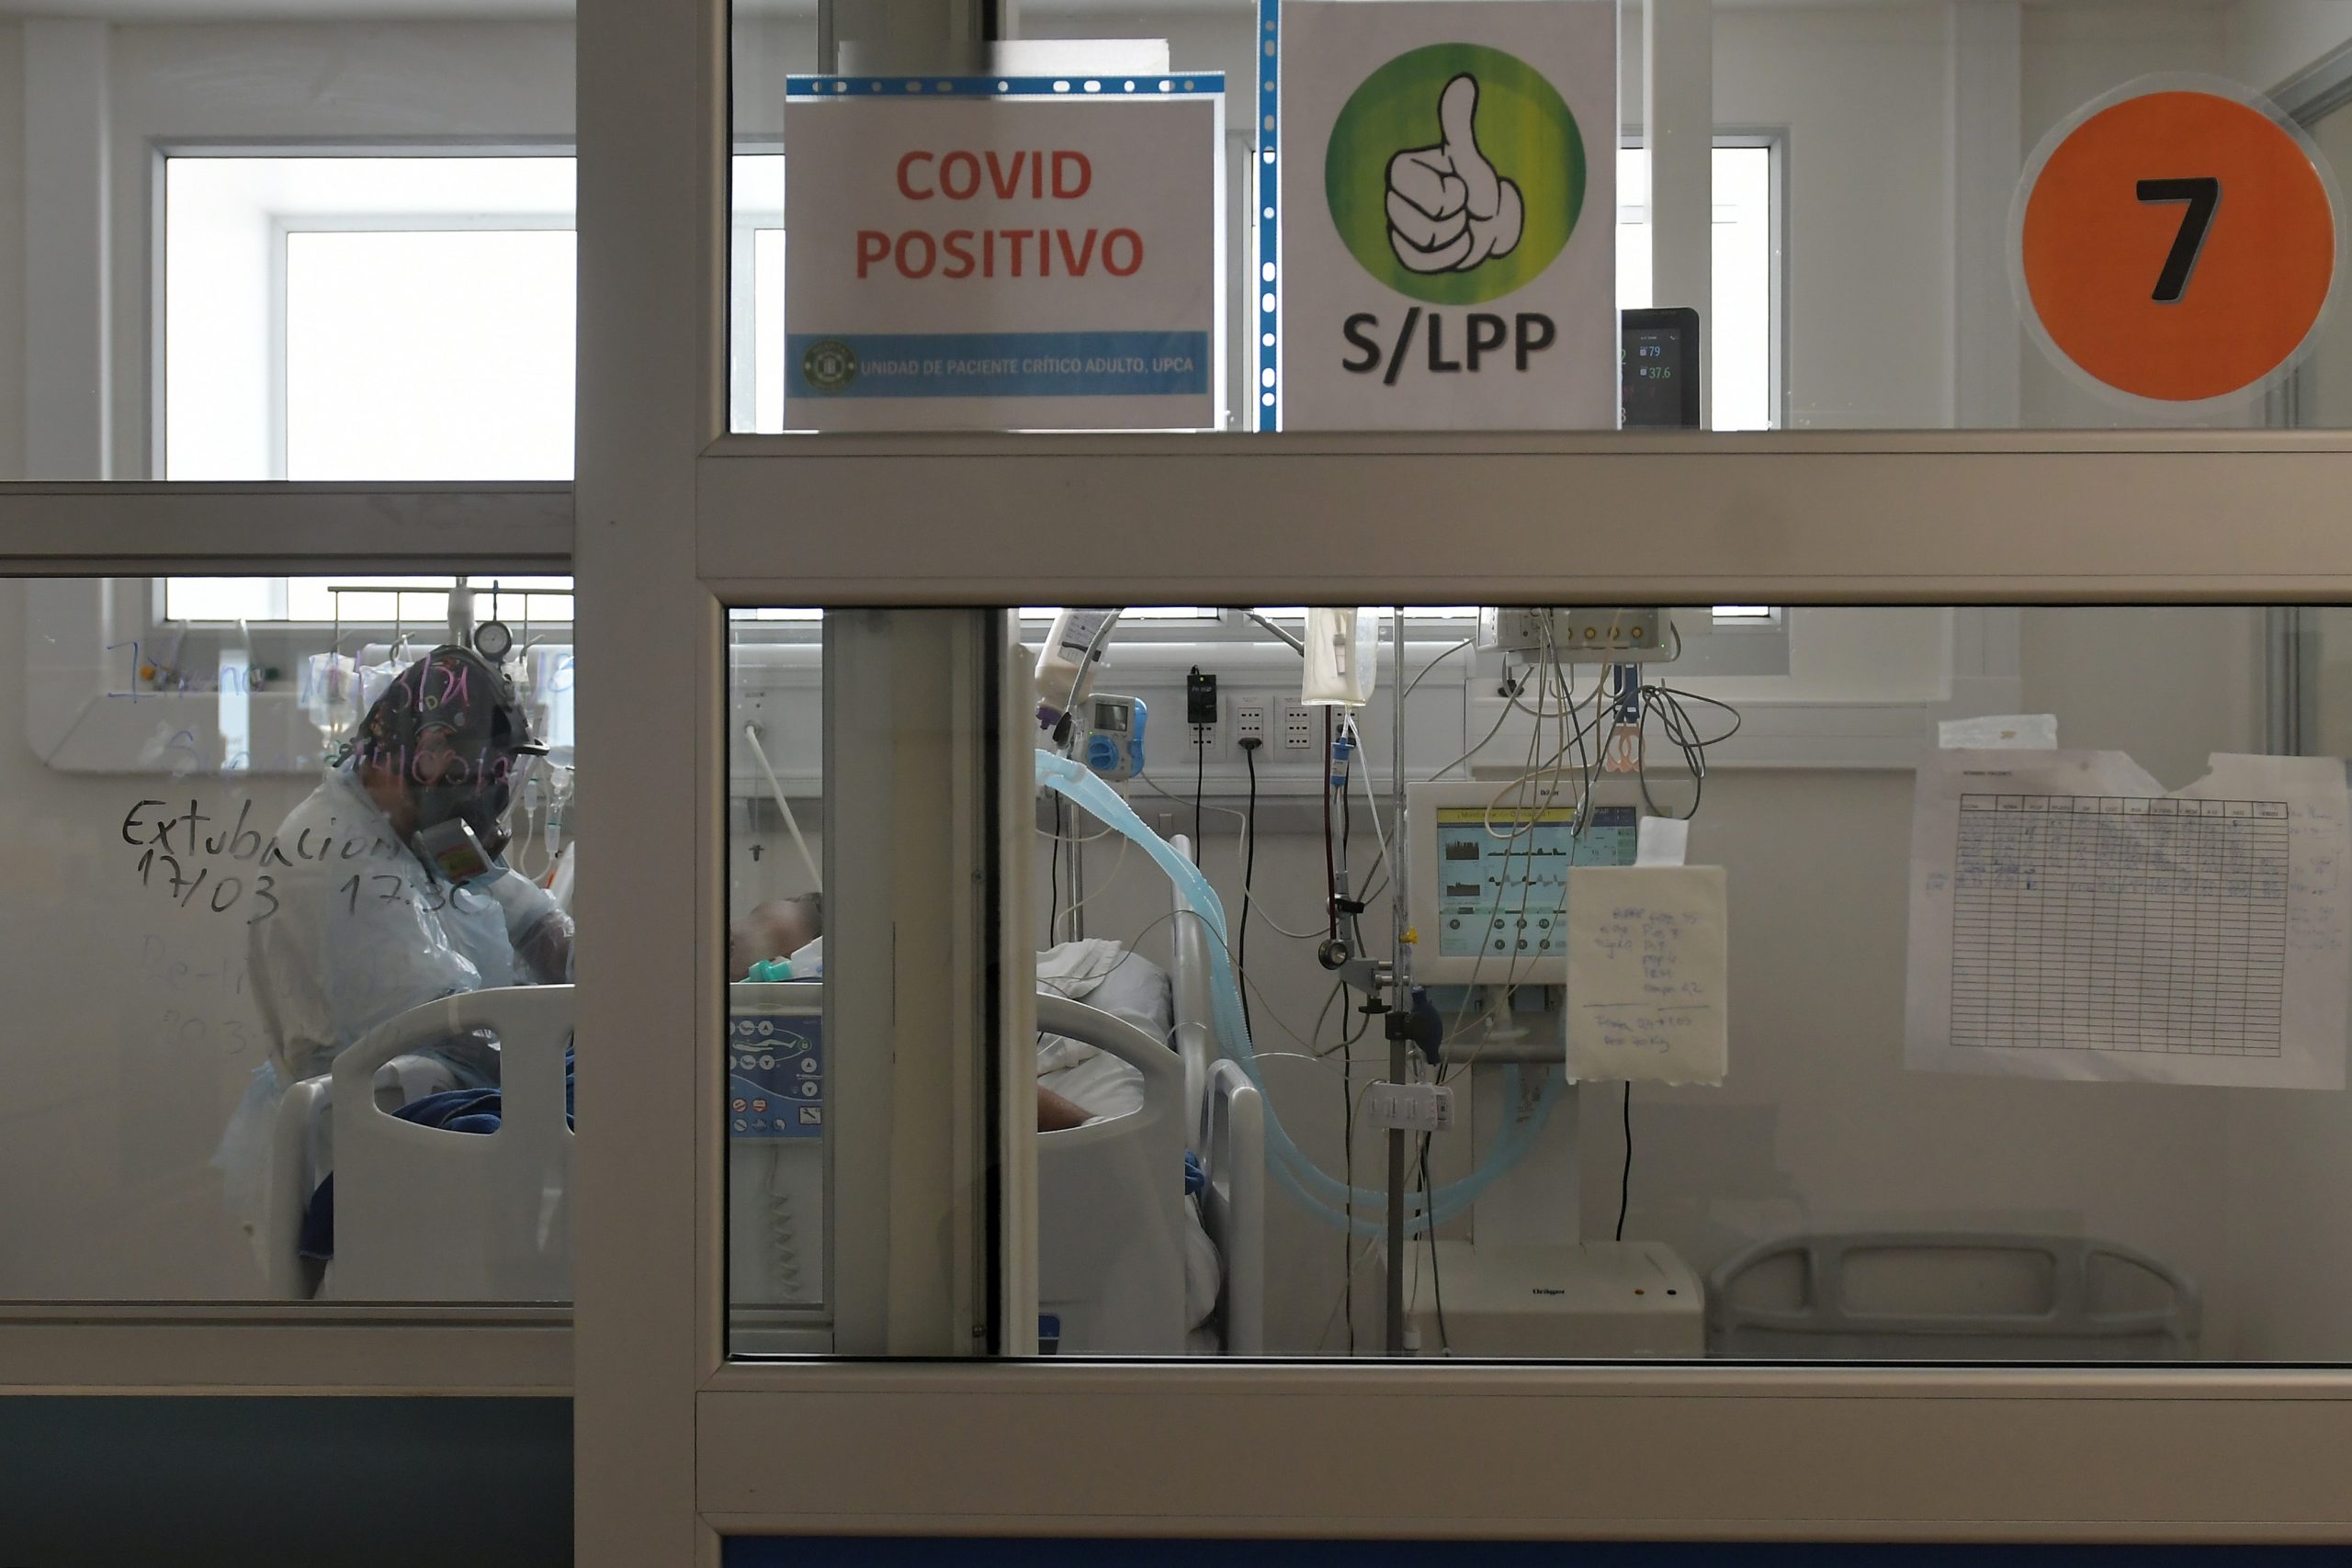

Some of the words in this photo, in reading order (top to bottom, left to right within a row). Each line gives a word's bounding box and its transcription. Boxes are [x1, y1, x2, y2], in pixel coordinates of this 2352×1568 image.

[896, 150, 1092, 200] COVID
[856, 228, 1144, 279] POSITIVO
[2135, 176, 2222, 302] 7
[860, 359, 918, 376] UNIDAD
[923, 359, 943, 375] DE
[947, 357, 1019, 375] PACIENTE
[1023, 355, 1081, 374] CRÍTICO
[1152, 356, 1194, 373] UPCA
[1341, 306, 1556, 387] S/LPP
[1648, 345, 1661, 357] 79
[1648, 367, 1671, 378] 37.6
[137, 848, 279, 925] 17/03
